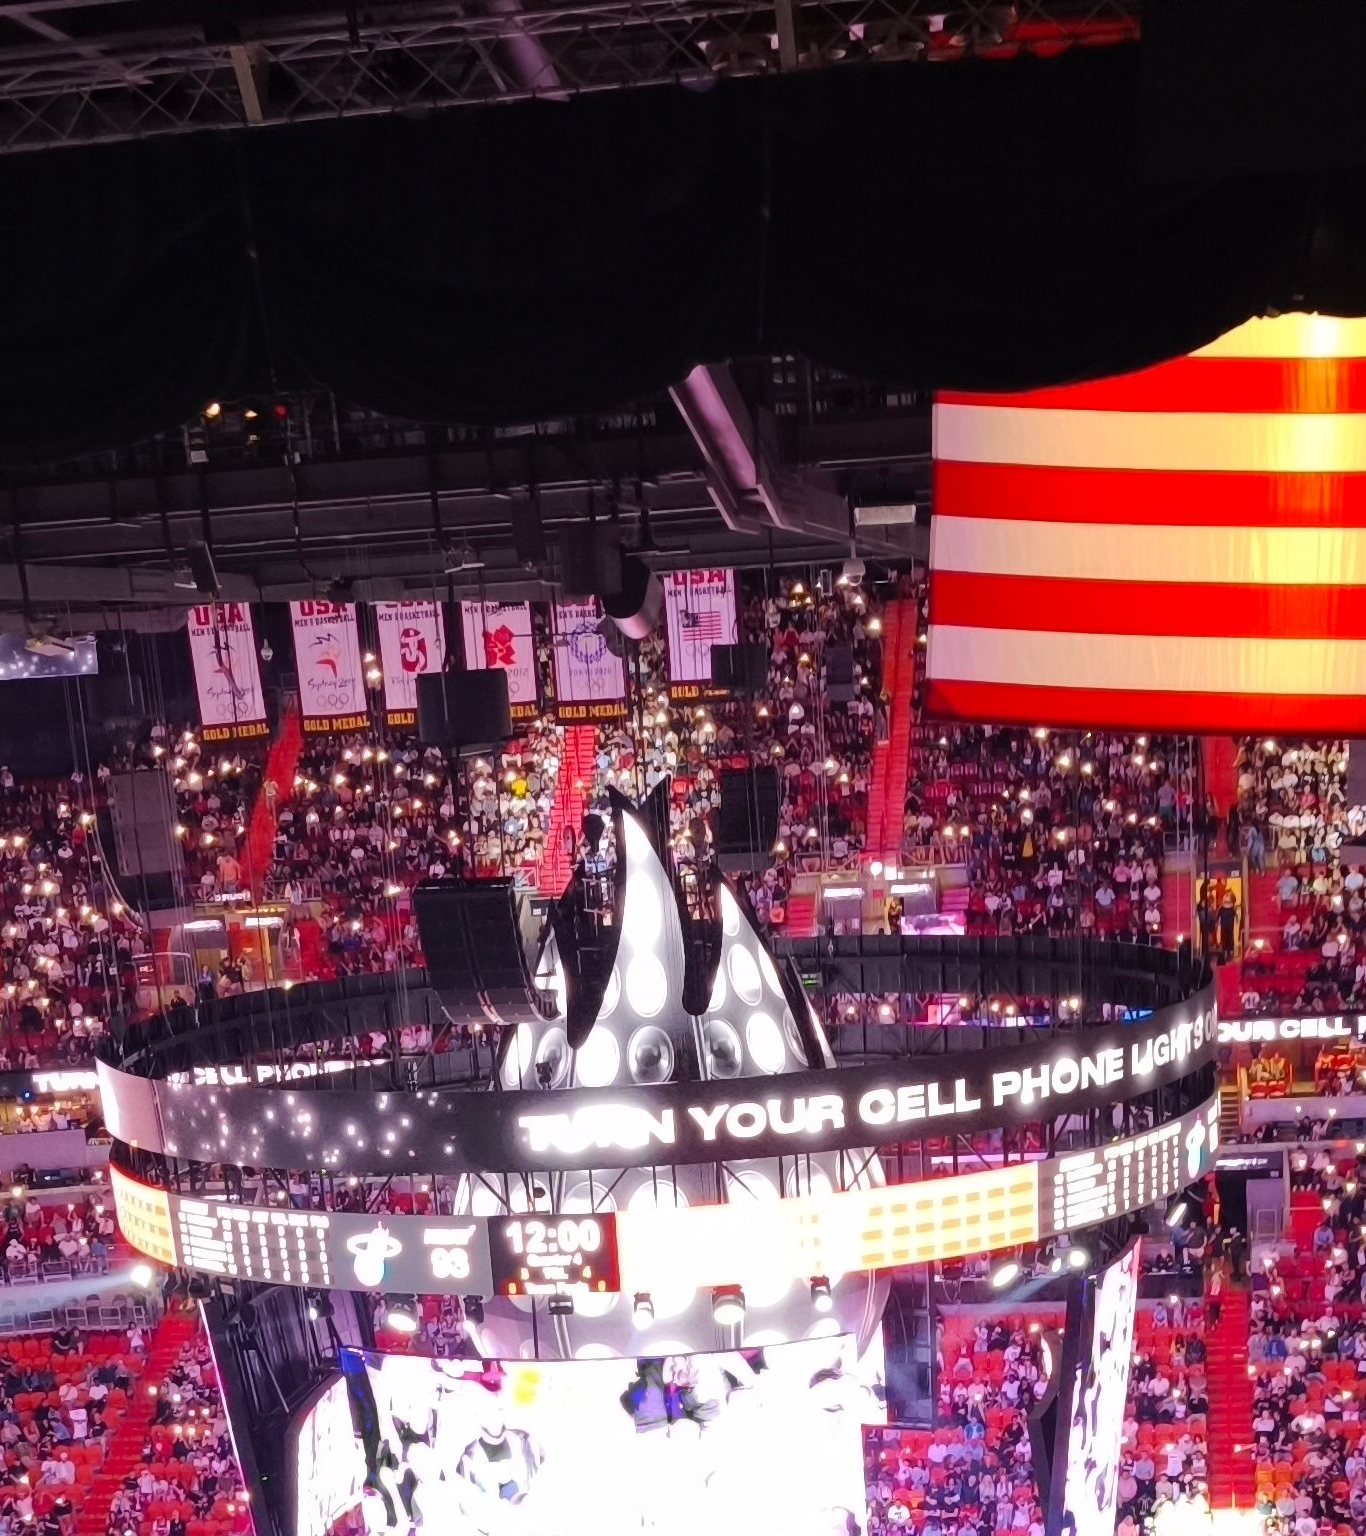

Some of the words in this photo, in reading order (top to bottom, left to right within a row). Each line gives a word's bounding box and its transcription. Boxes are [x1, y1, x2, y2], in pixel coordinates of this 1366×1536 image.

[299, 600, 348, 617] USA
[671, 685, 700, 699] GOLD
[387, 711, 415, 725] GOLD
[511, 703, 539, 718] EDAL
[558, 705, 586, 719] GOLD
[589, 700, 628, 717] MEDAL
[303, 718, 332, 732] GOLD
[334, 714, 371, 730] MEDAL
[203, 727, 230, 741] GOLD
[1218, 1016, 1276, 1043] OUR
[1278, 1015, 1352, 1040] CELL
[518, 1104, 676, 1152] TURN
[687, 1094, 846, 1141] YOUR
[858, 1078, 982, 1126] CELL
[992, 1047, 1124, 1107] PHONE
[1130, 1015, 1205, 1077] LIGHTS
[505, 1219, 602, 1254] 12:00
